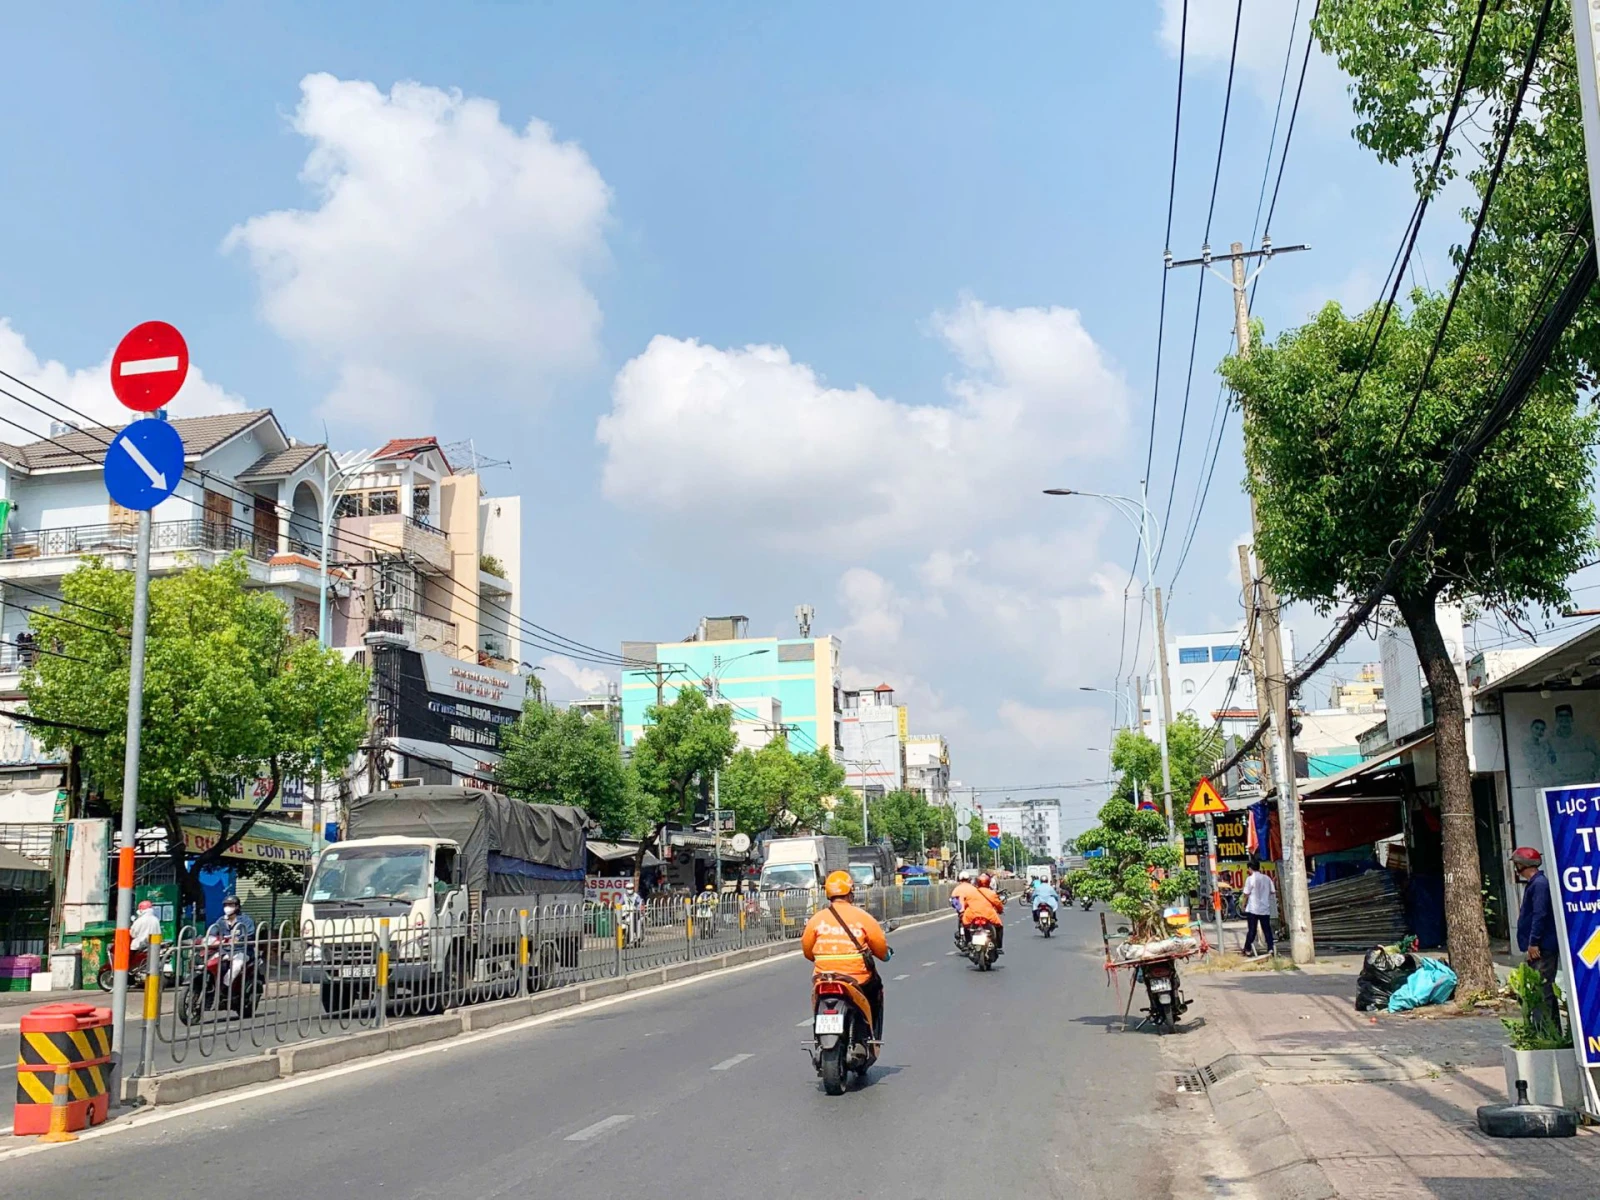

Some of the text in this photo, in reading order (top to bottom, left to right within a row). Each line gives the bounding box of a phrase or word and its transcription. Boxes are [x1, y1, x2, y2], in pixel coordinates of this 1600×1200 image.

[1556, 798, 1587, 816] LỤC
[256, 842, 285, 859] CƠM
[1218, 839, 1245, 856] THÌN
[1566, 902, 1579, 912] Tu
